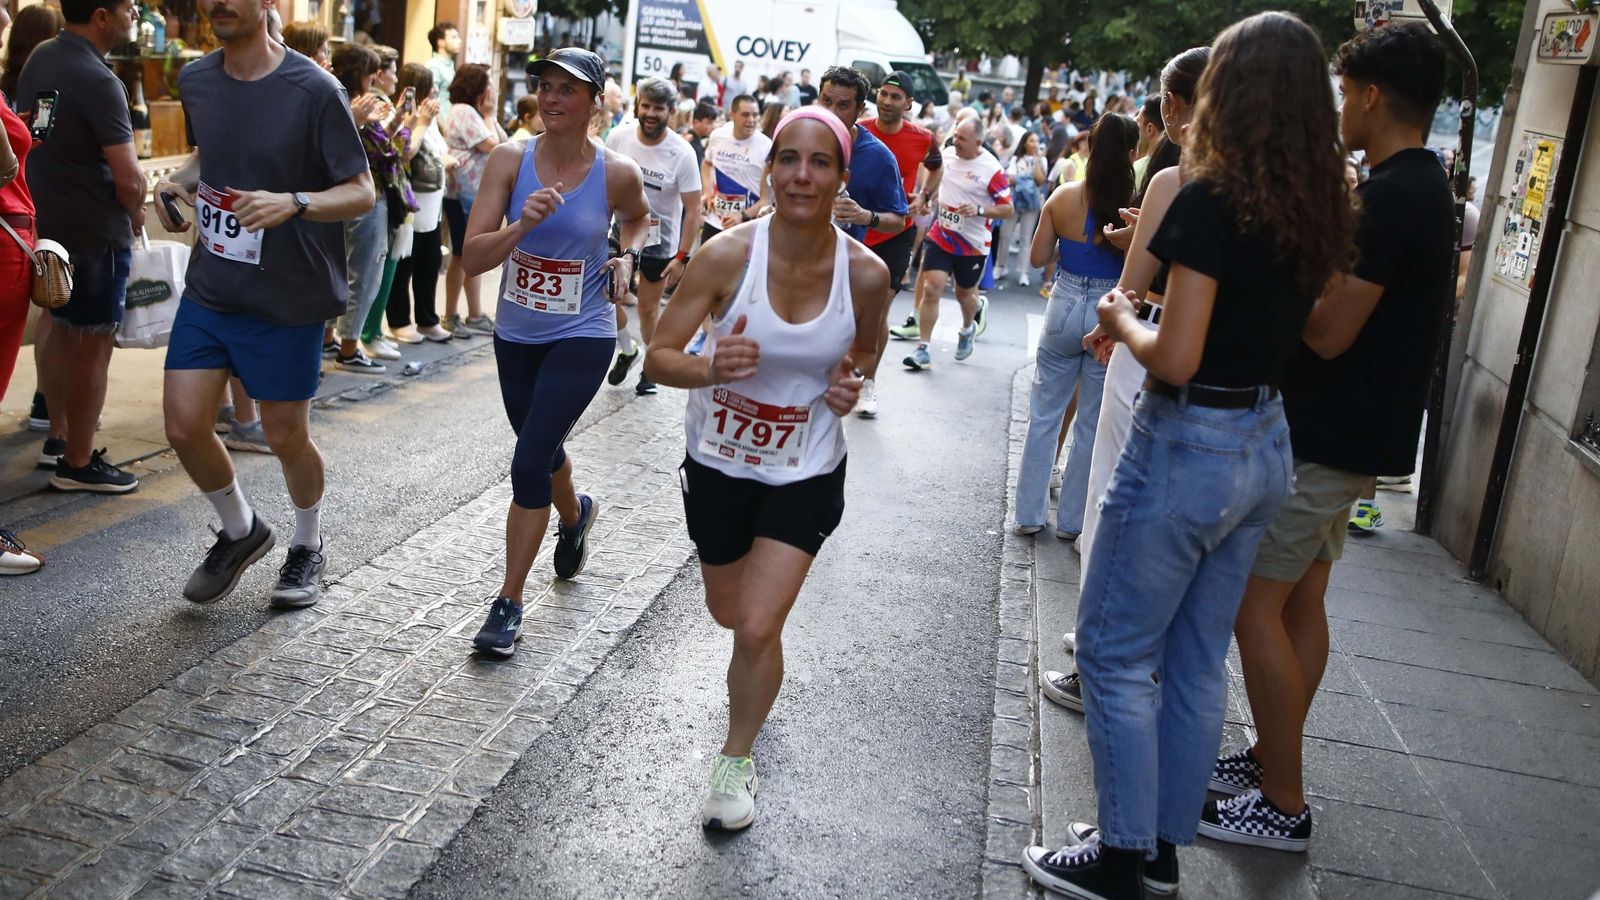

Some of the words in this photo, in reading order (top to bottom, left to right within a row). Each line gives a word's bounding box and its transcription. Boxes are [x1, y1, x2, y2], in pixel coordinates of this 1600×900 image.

[650, 28, 687, 38] merecen
[651, 36, 698, 48] descuento!
[736, 35, 811, 62] COVEY
[715, 199, 741, 211] 3274
[202, 204, 241, 239] 919
[516, 267, 562, 297] 823
[714, 389, 728, 403] 39
[713, 408, 796, 450] 1797
